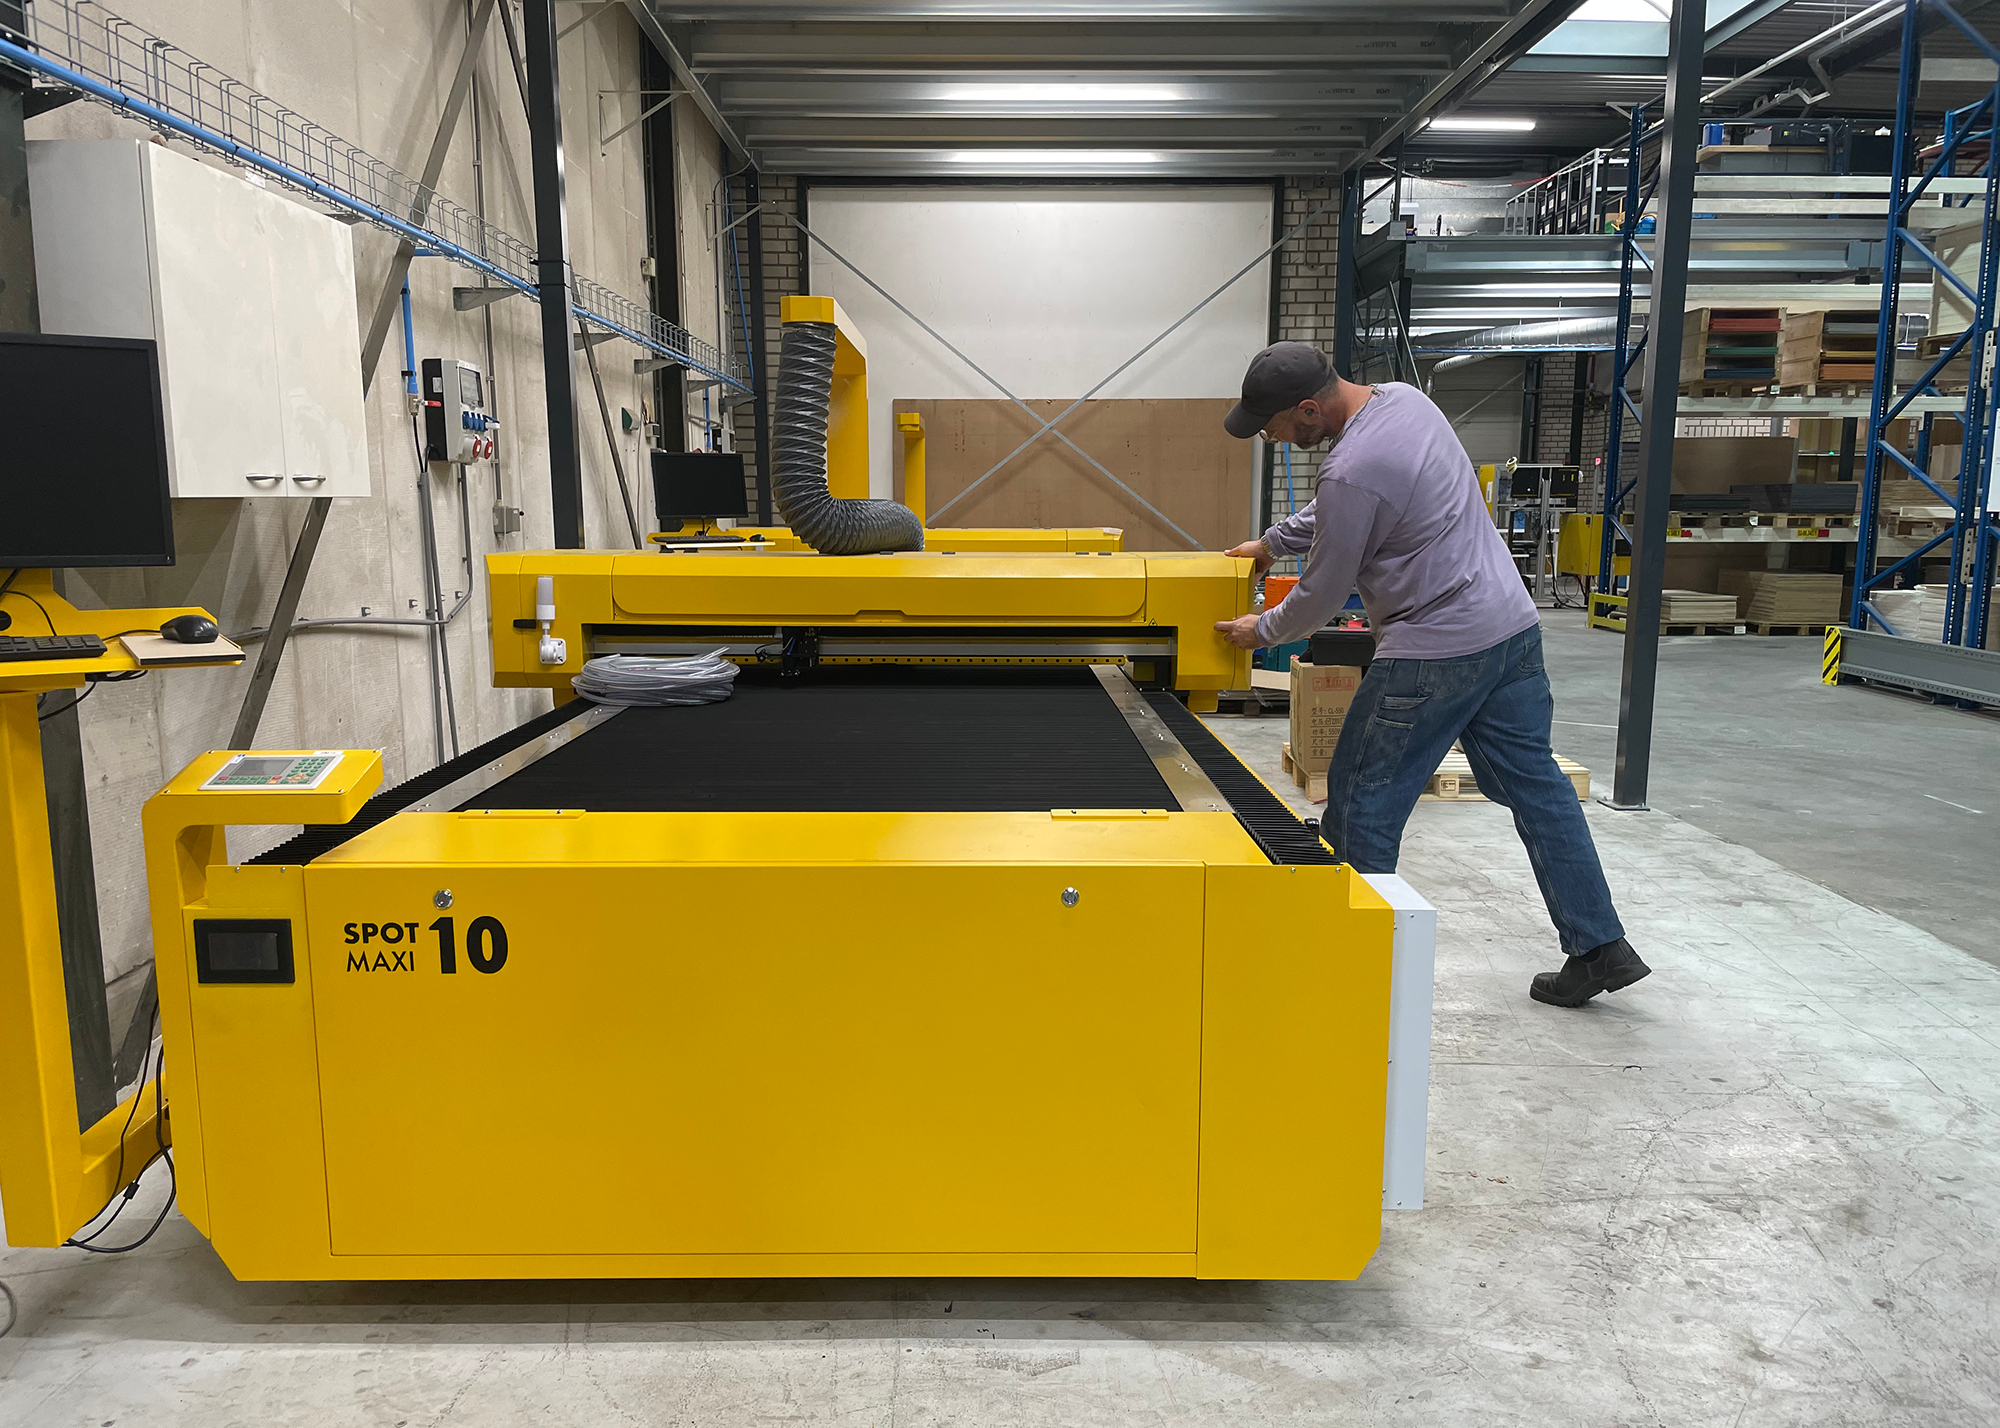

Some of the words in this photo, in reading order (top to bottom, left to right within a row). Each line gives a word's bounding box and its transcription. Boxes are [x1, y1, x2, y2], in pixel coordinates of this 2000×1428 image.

[344, 922, 420, 944] SPOT
[428, 915, 509, 974] 10
[346, 950, 415, 972] MAXI
